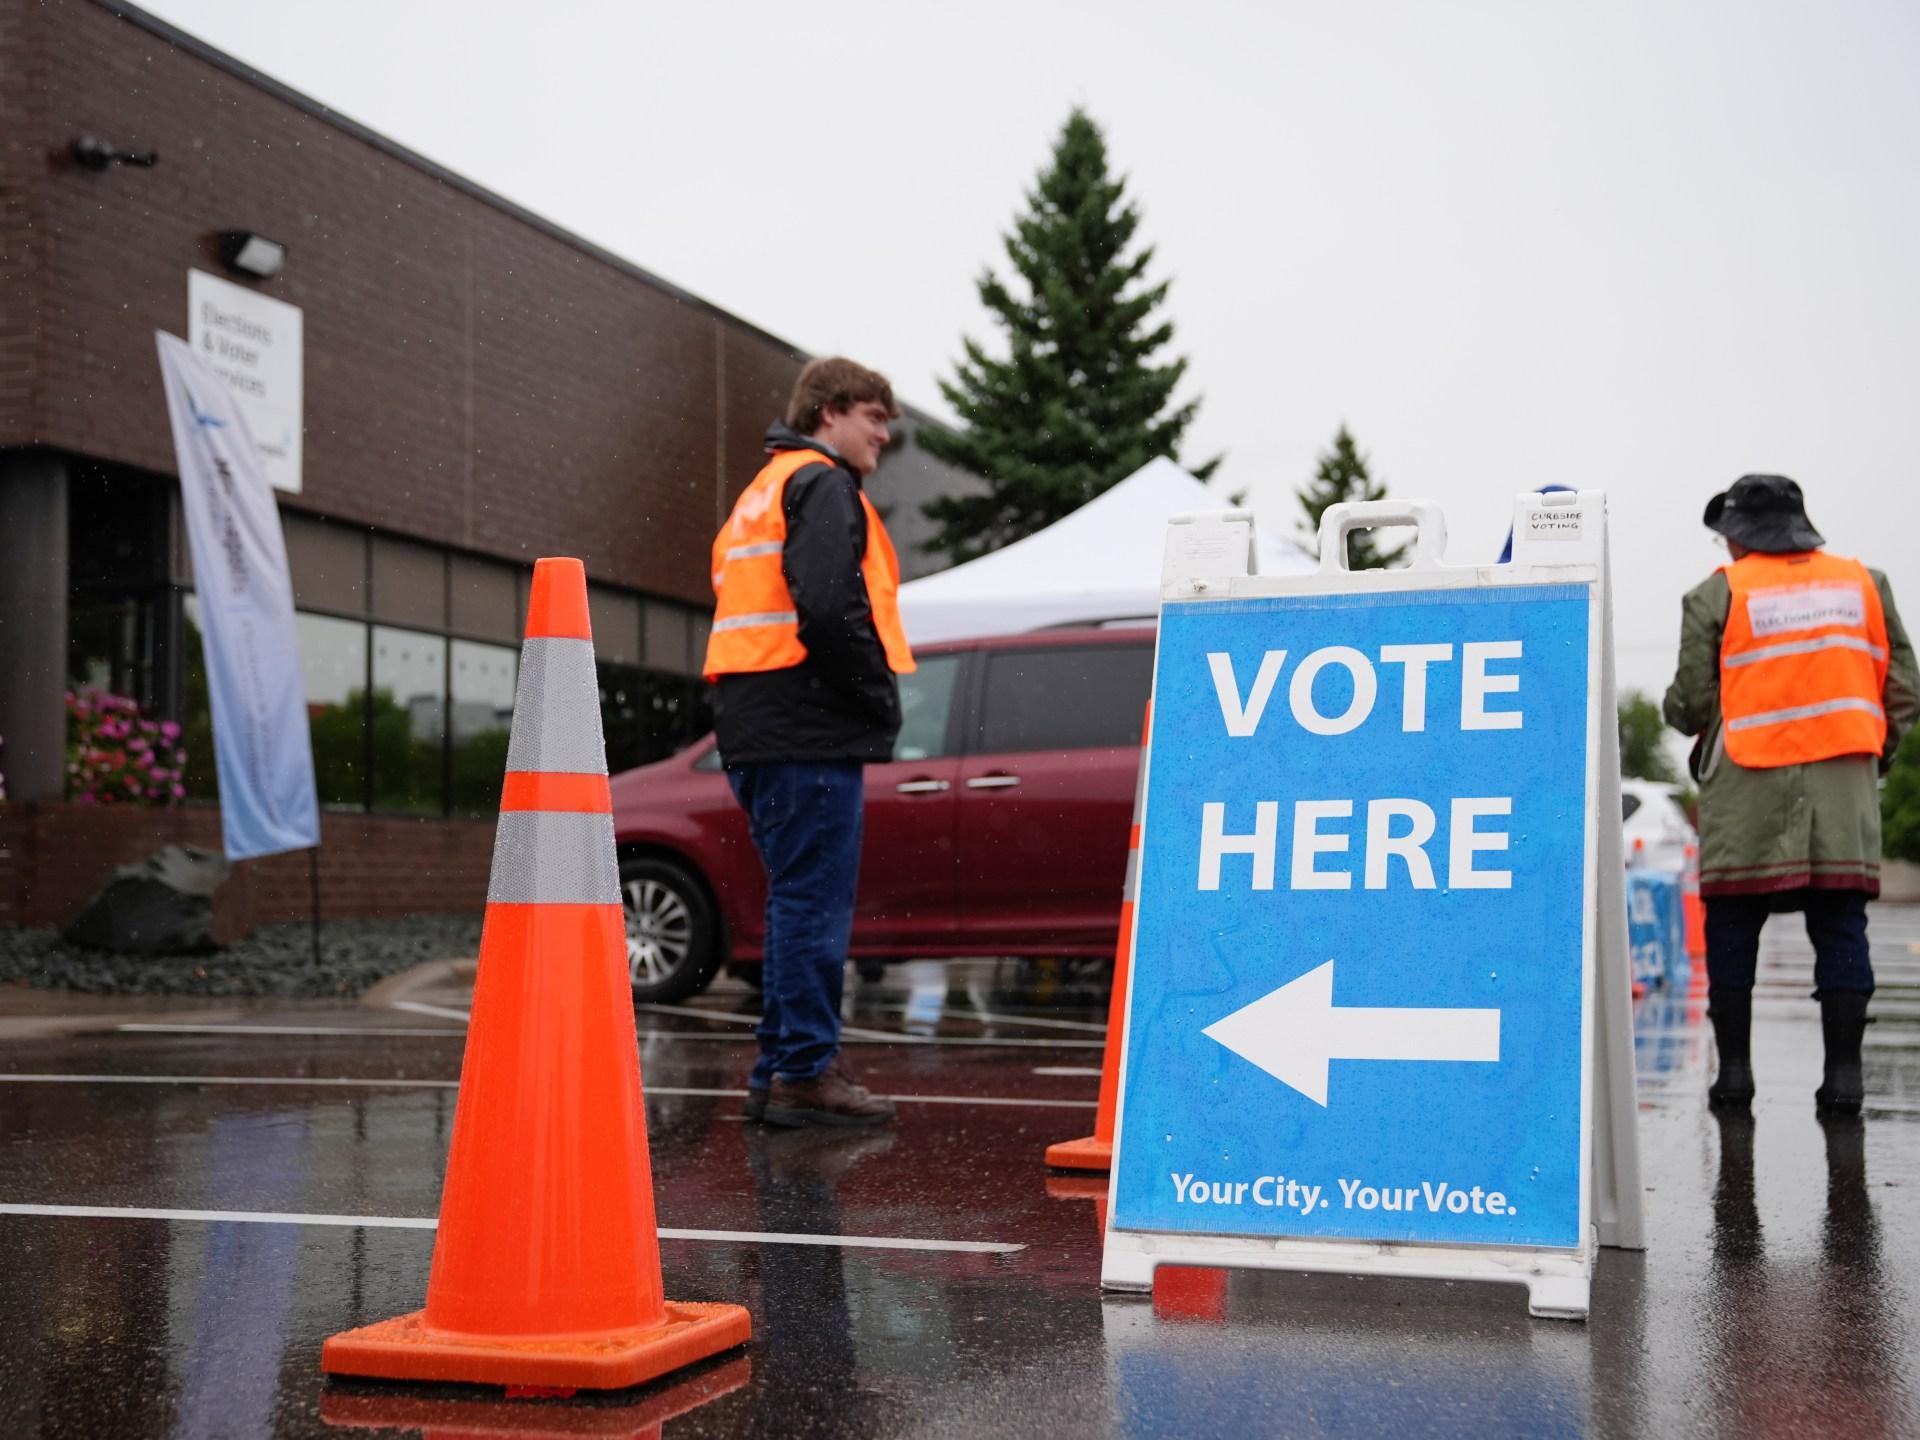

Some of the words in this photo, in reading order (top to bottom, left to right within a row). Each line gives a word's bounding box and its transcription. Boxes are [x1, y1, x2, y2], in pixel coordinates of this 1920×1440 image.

[1531, 512, 1582, 521] CURBSIDE
[1531, 522, 1579, 530] VOTING
[1206, 640, 1524, 737] VOTE
[1197, 797, 1513, 891] HERE
